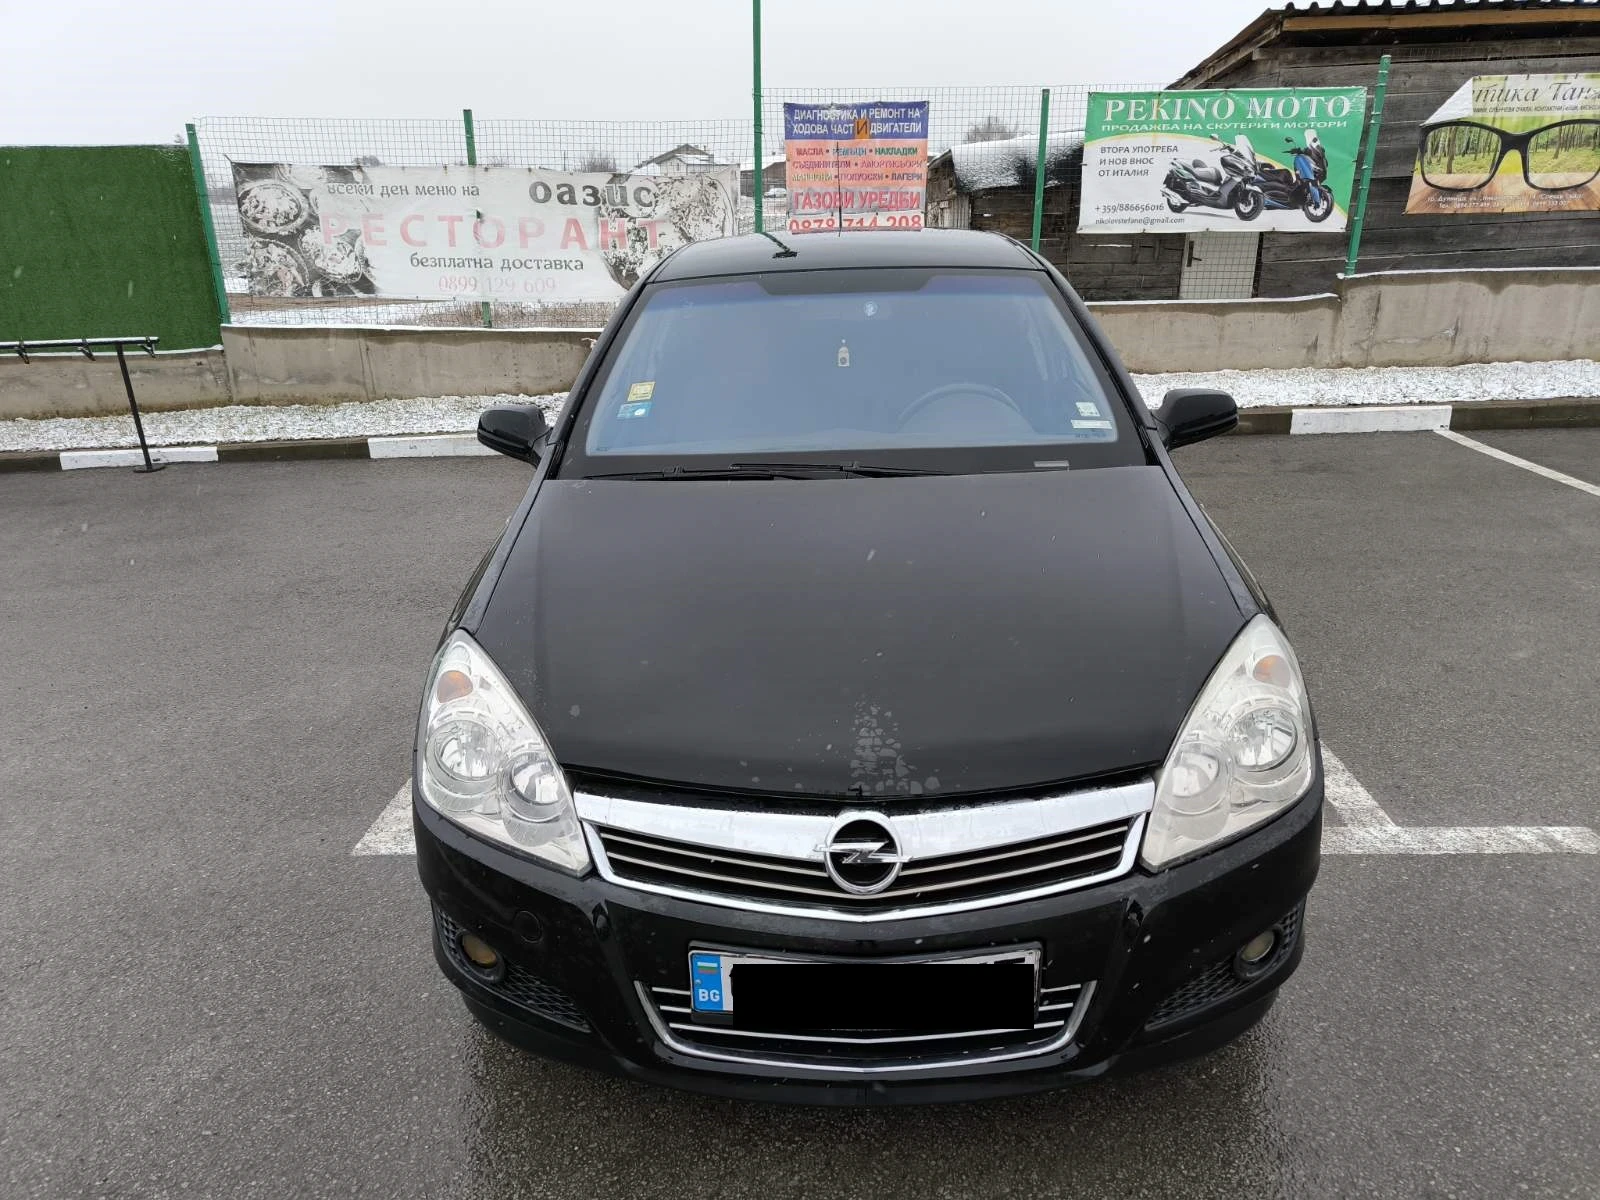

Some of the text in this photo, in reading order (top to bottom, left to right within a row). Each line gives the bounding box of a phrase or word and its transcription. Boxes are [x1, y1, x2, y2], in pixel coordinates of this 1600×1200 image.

[1472, 84, 1540, 102] тика
[793, 108, 921, 121] ДИАГНОСТИКА И РЕМОНТ НА
[1104, 95, 1351, 121] PEKINO MOTO
[793, 120, 922, 135] ХОДОВА ЧАСТ И ДВИГАТЕЛИ
[1102, 123, 1180, 132] ПРОДАЖБА
[1206, 122, 1268, 130] СКУТЕРИ
[1284, 121, 1348, 129] МОТОРИ
[796, 148, 823, 156] МАСЛА
[875, 147, 918, 157] НАКЛАДКИ
[891, 173, 922, 181] ЛАГЕРИ
[380, 184, 409, 198] ден
[415, 186, 457, 196] меню
[462, 185, 480, 196] на
[528, 180, 656, 208] оазис
[794, 191, 921, 210] ГАЗОВИ УРЕДБИ
[322, 212, 667, 251] РЕСТОРАНТ
[410, 252, 584, 271] безплатна доставка
[438, 276, 477, 292] 0899
[698, 989, 720, 1002] BG
